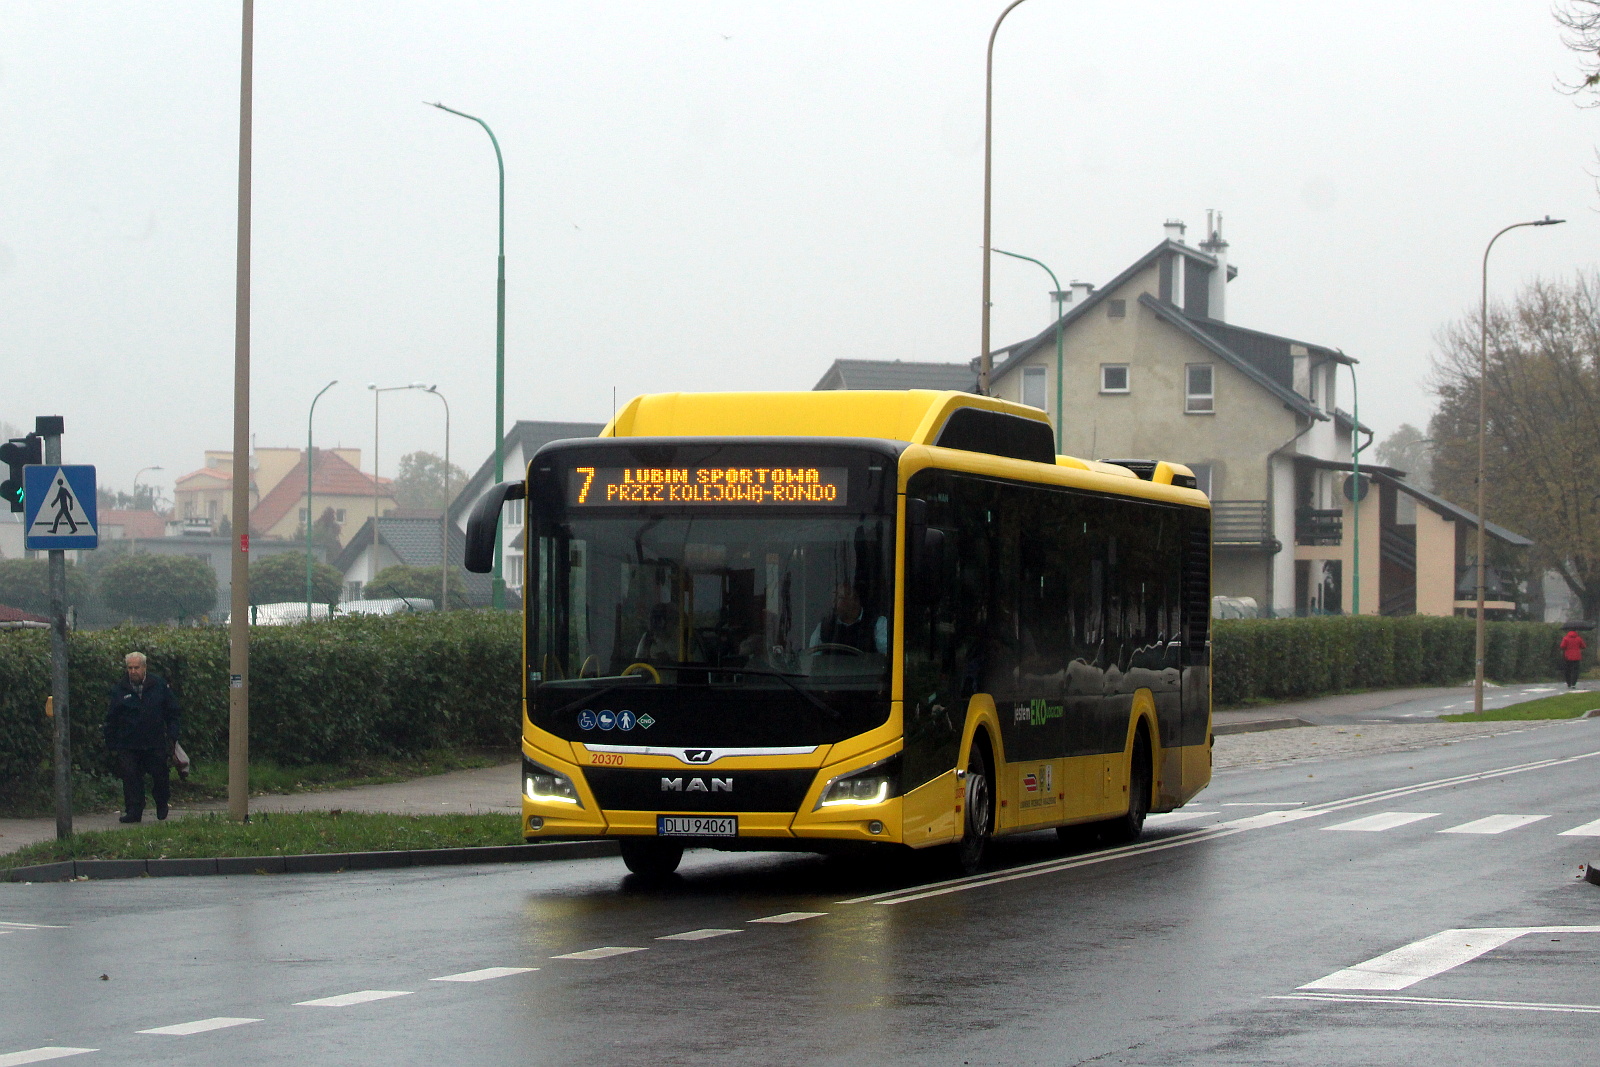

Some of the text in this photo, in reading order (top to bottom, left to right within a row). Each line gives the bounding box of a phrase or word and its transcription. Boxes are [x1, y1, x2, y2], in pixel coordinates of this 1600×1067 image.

[624, 469, 819, 484] LUBIN SPORTOWA
[576, 467, 595, 503] 7
[607, 484, 664, 501] PRZEZ
[591, 753, 624, 765] 20370
[661, 777, 734, 792] MAN
[665, 818, 733, 834] DLU 94061
